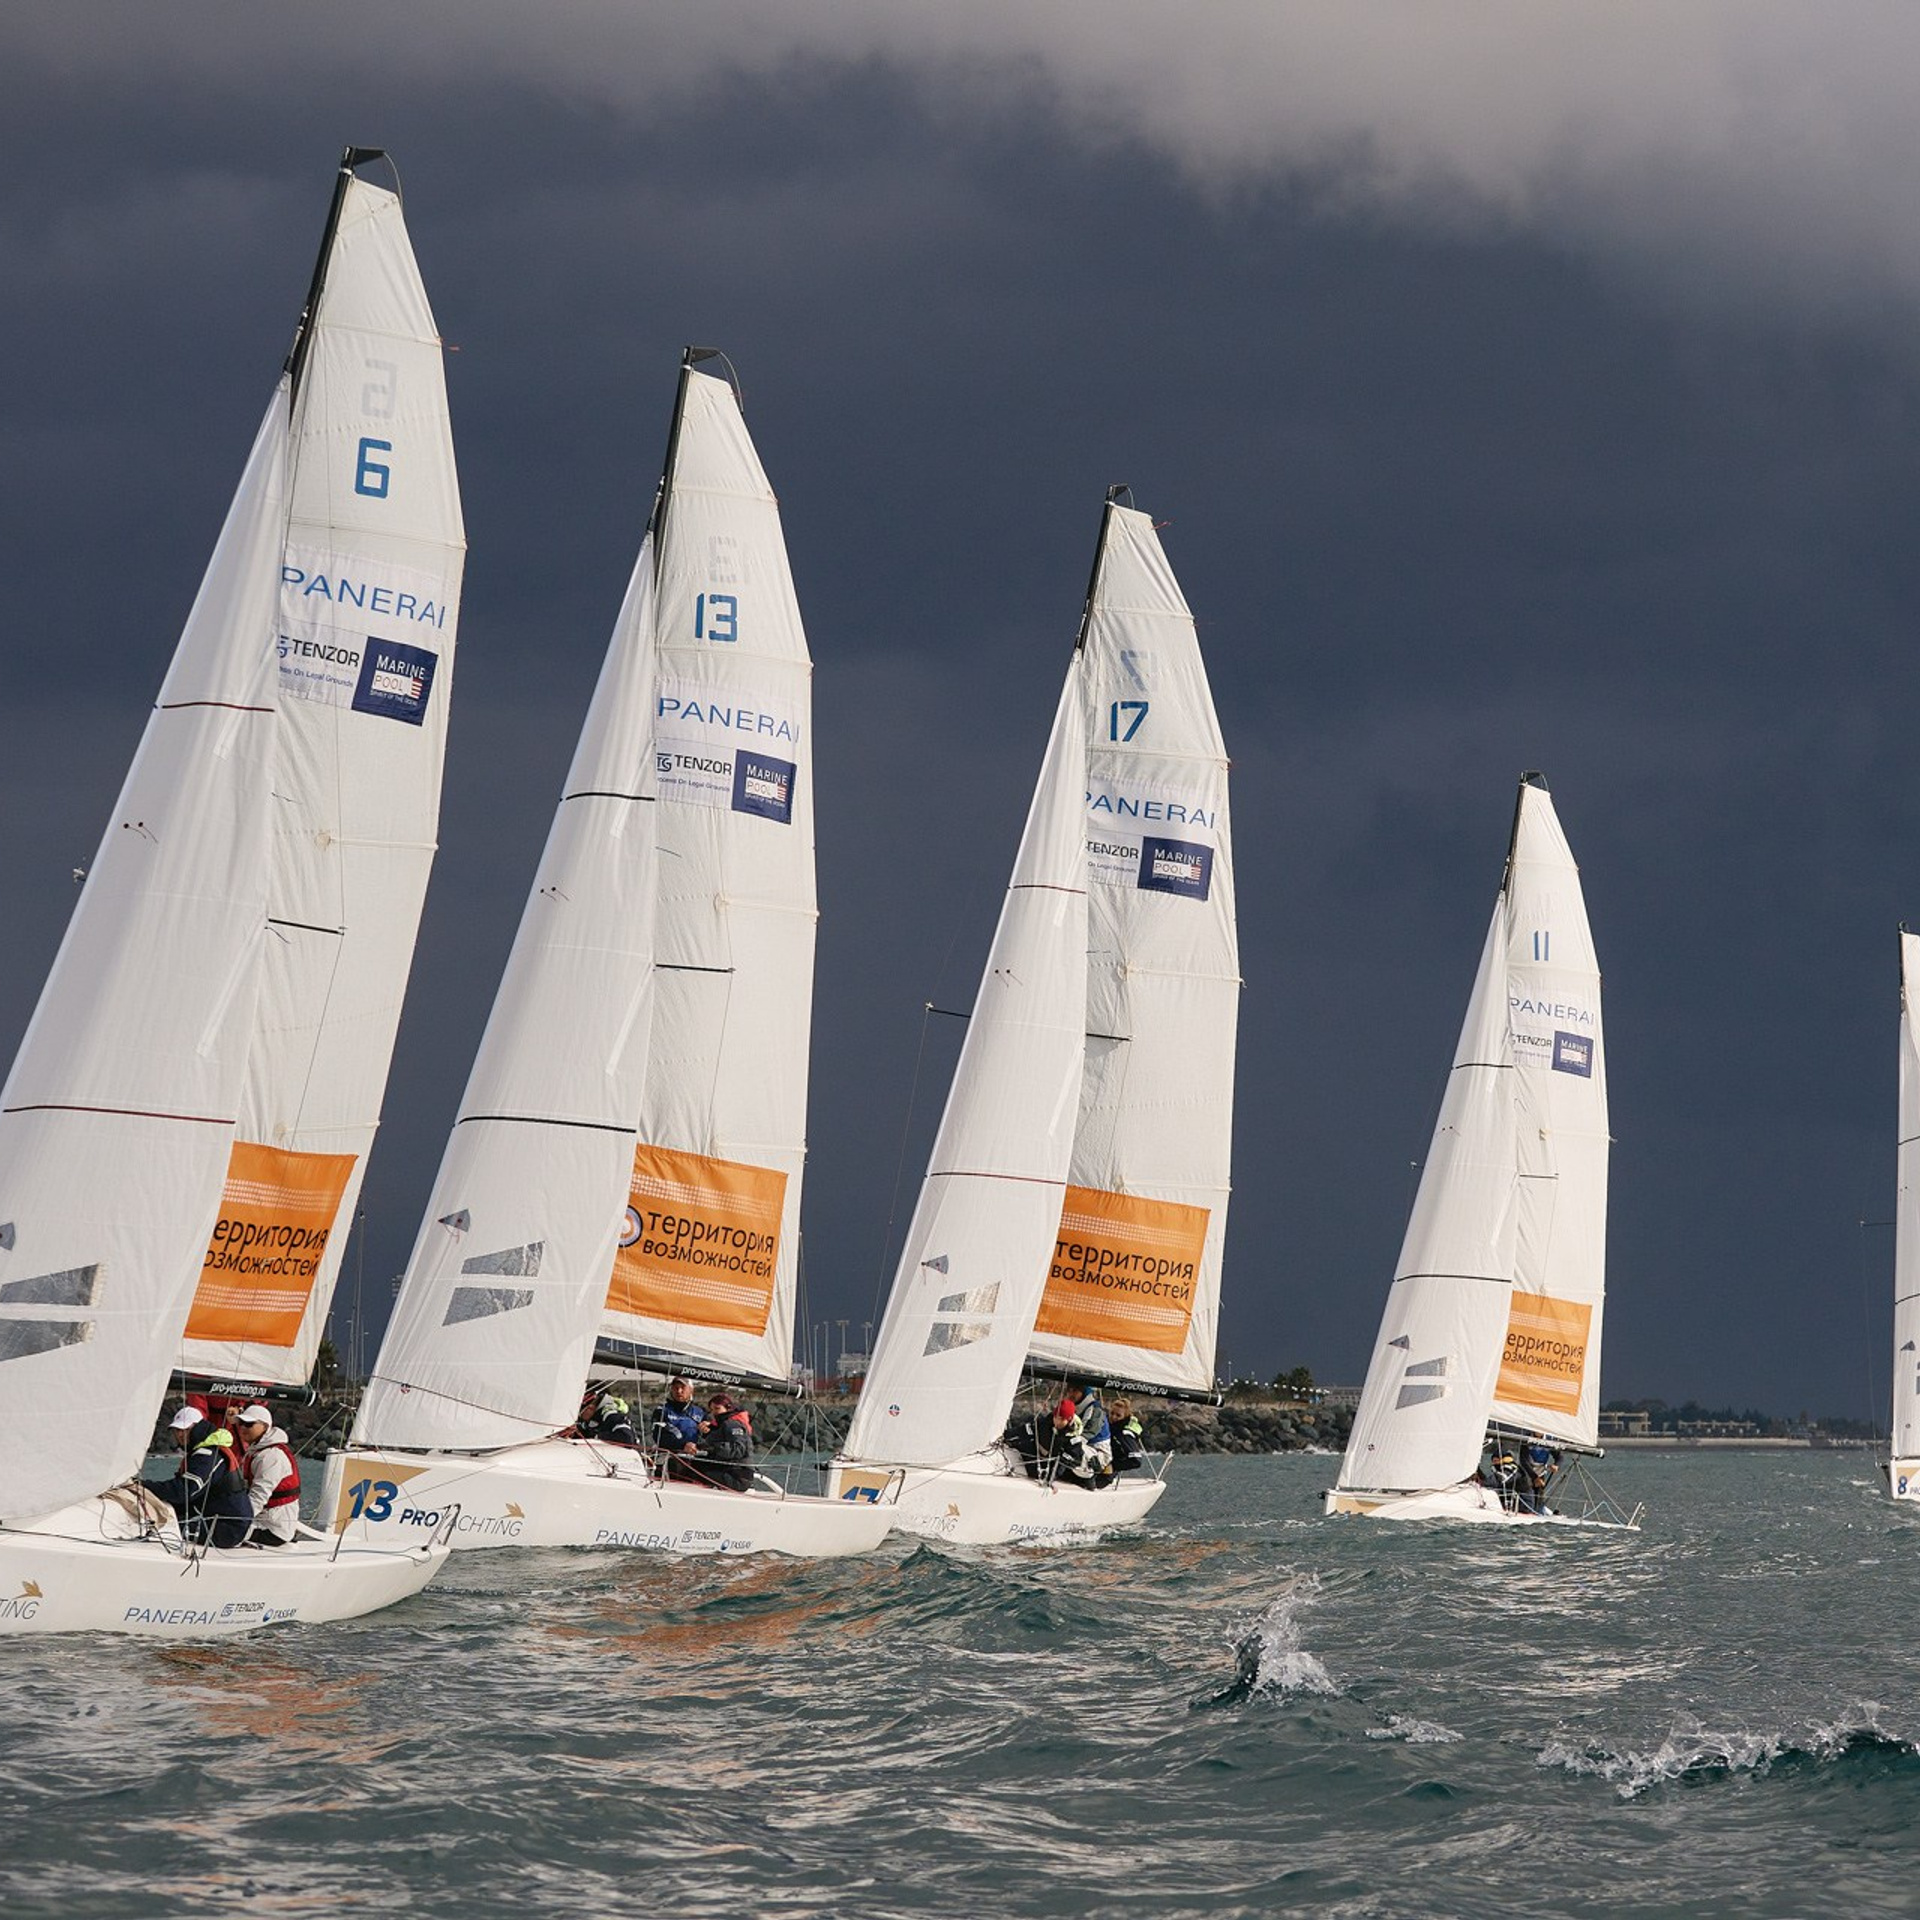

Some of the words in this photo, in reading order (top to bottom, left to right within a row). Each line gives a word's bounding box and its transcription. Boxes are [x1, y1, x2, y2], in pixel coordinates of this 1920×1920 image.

[354, 436, 392, 499] 6
[281, 564, 446, 630] PANERAI
[694, 592, 738, 643] 13
[292, 639, 360, 667] TENZOR
[376, 654, 426, 680] MARINE
[374, 674, 404, 691] POOL
[658, 697, 800, 744] PANERAI
[1109, 700, 1149, 743] 17
[674, 754, 732, 776] TENZOR
[746, 764, 788, 786] MARINE
[1086, 791, 1215, 829] ANERAI
[1086, 841, 1139, 860] TENZOR
[1154, 848, 1203, 867] MARINE
[1533, 930, 1549, 961] 11
[1516, 1034, 1553, 1048] TENZOR
[213, 1218, 329, 1257] ерритория
[647, 1210, 775, 1258] территория
[203, 1250, 320, 1277] озможностей
[642, 1238, 772, 1278] возможностей
[1056, 1240, 1194, 1282] территория
[1051, 1264, 1190, 1301] возможностей
[1507, 1333, 1584, 1362] ерритория
[680, 1366, 741, 1384] pro-yachting.ru
[1502, 1350, 1582, 1375] озможностей
[209, 1383, 267, 1398] pro-yachting.ru
[1104, 1380, 1168, 1396] pro-yachting.ru
[1897, 1475, 1908, 1495] 8
[348, 1478, 398, 1522] 13
[596, 1529, 678, 1549] PANERAI
[124, 1606, 217, 1625] PANERAI
[234, 1602, 265, 1613] TENZOR
